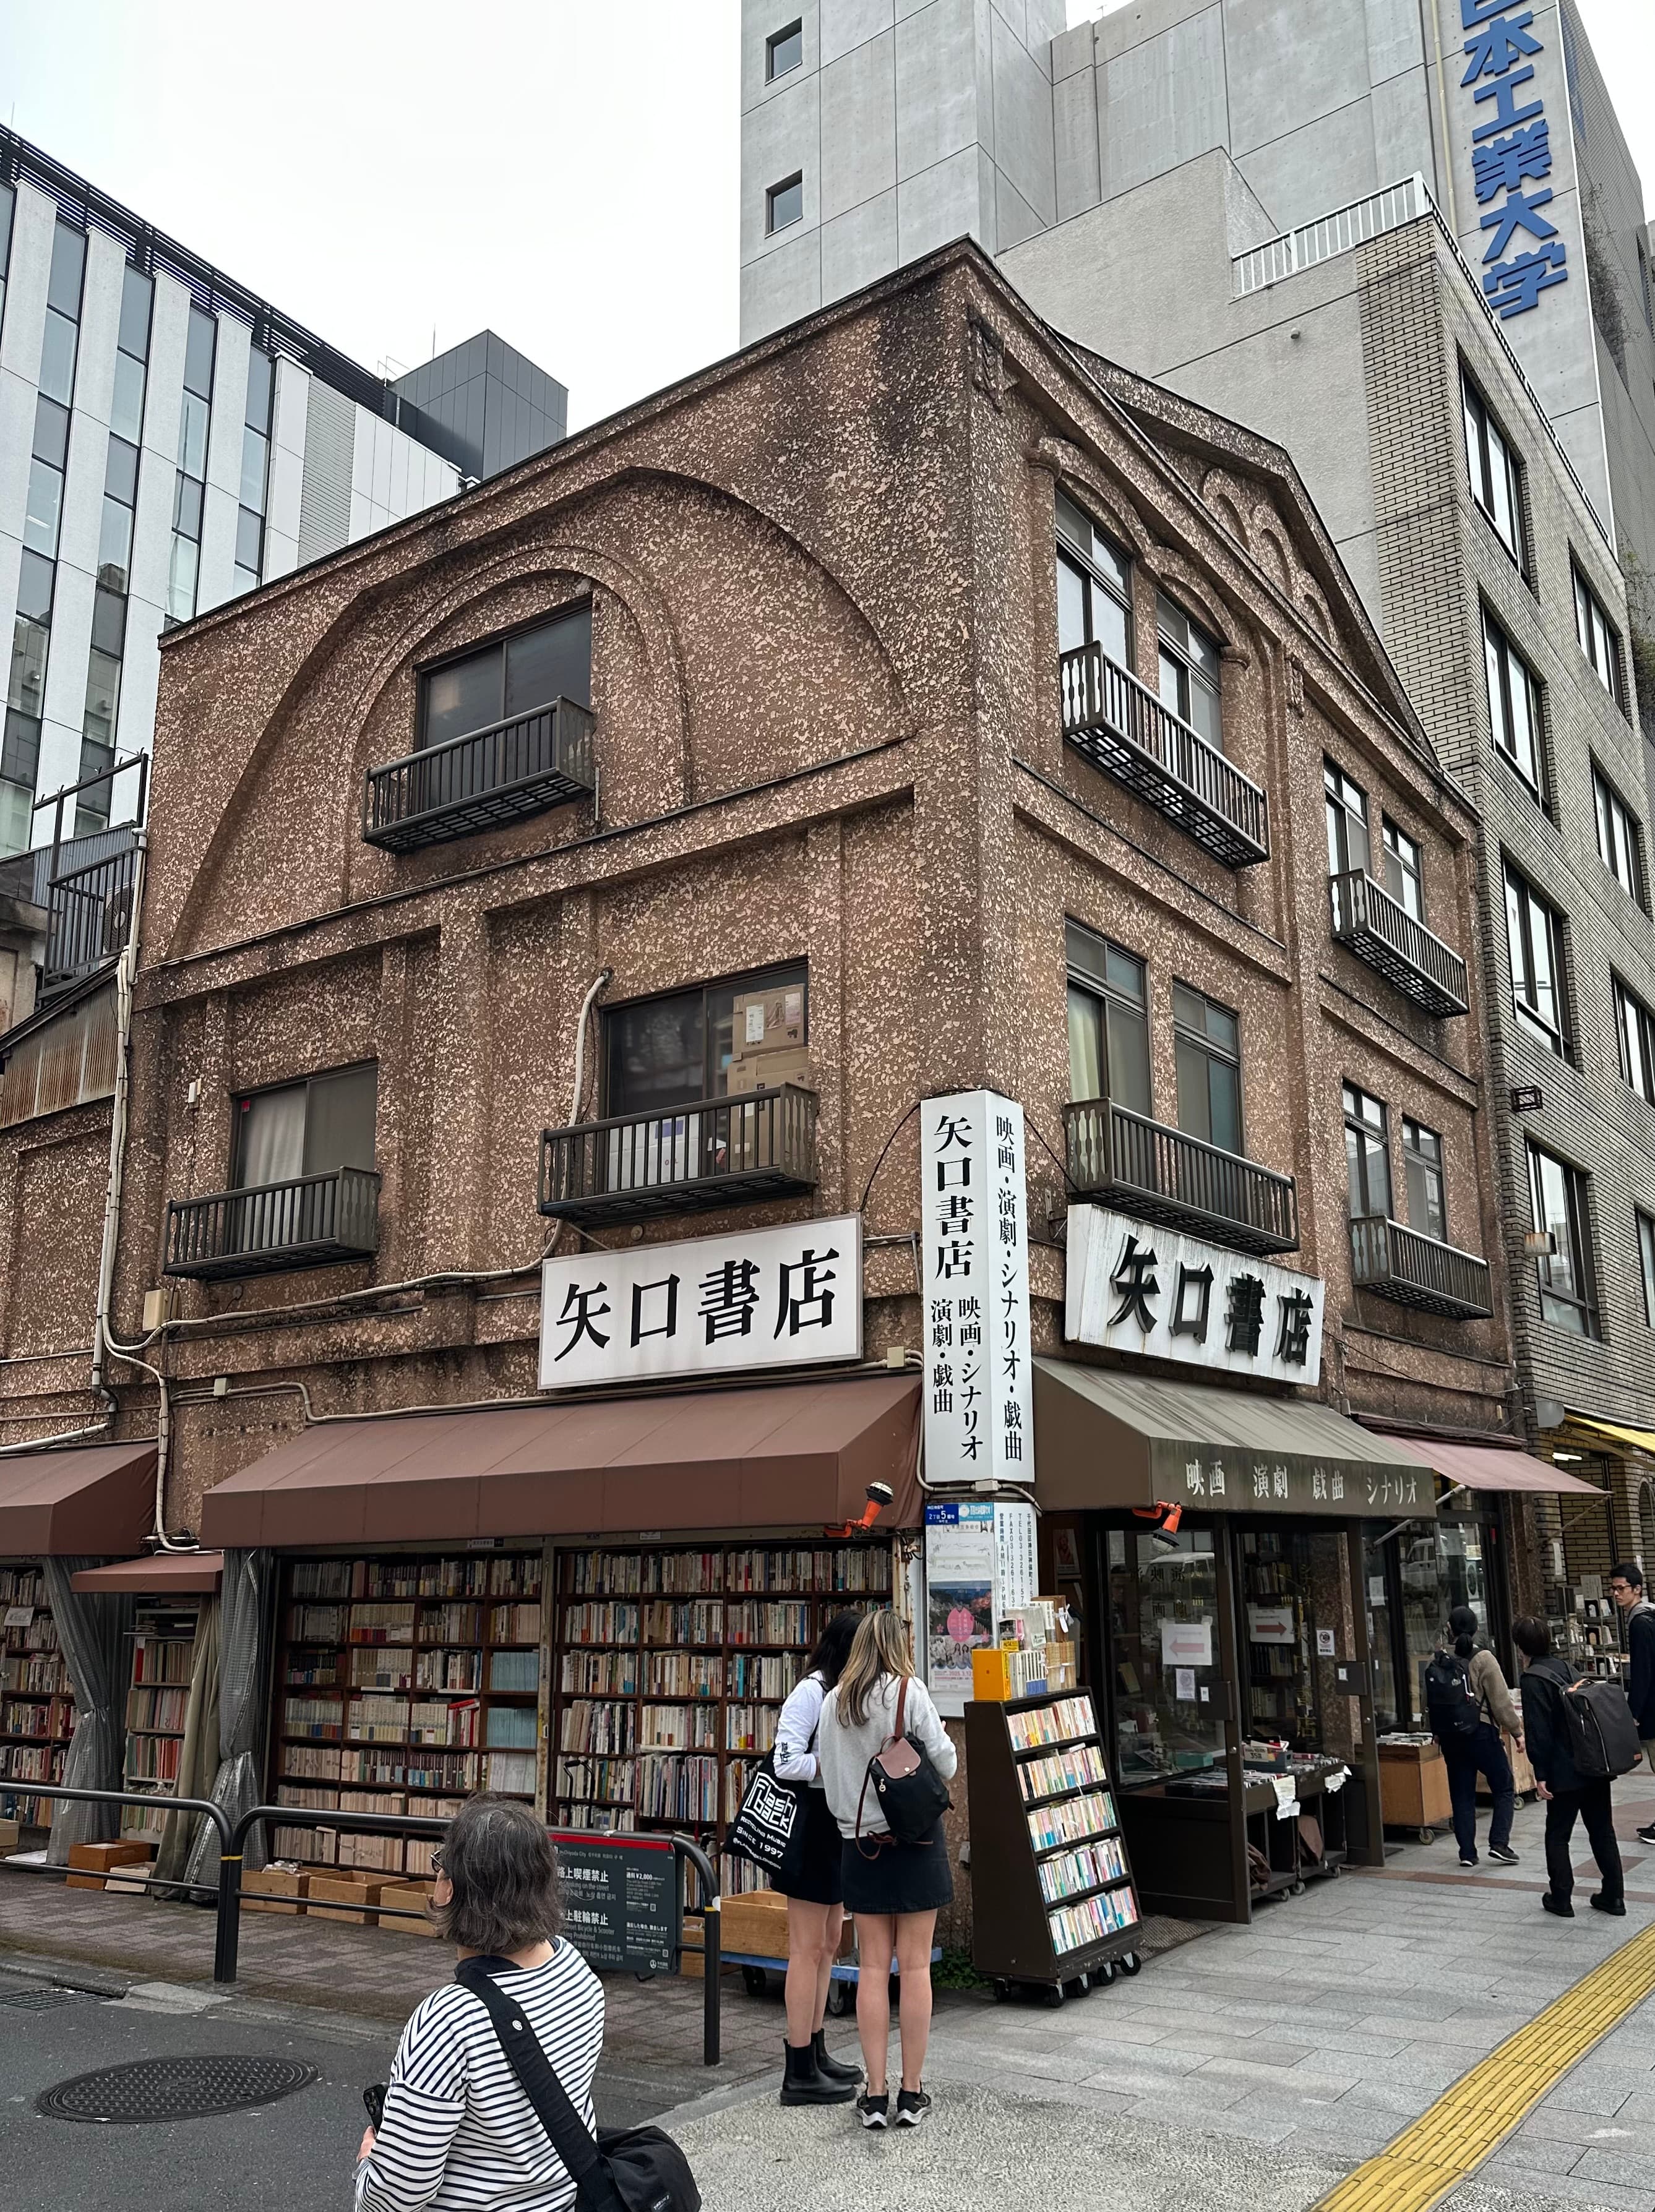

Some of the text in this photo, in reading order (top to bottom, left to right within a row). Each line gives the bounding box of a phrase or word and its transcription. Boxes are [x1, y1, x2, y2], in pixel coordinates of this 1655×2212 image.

[934, 1115, 973, 1280] 矢口書店
[554, 1248, 840, 1362] 矢口書店
[996, 1117, 1023, 1462] 映画・演劇・シナリオ・戯曲
[1107, 1233, 1313, 1366] 矢口書店
[931, 1300, 954, 1414] 演劇・戯曲
[958, 1296, 983, 1460] 映画・シナリオ
[1185, 1459, 1417, 1505] 映画 演劇 戯曲 シナリオ
[760, 1842, 783, 1858] 1997
[565, 1910, 609, 1926] 上駐輪禁止
